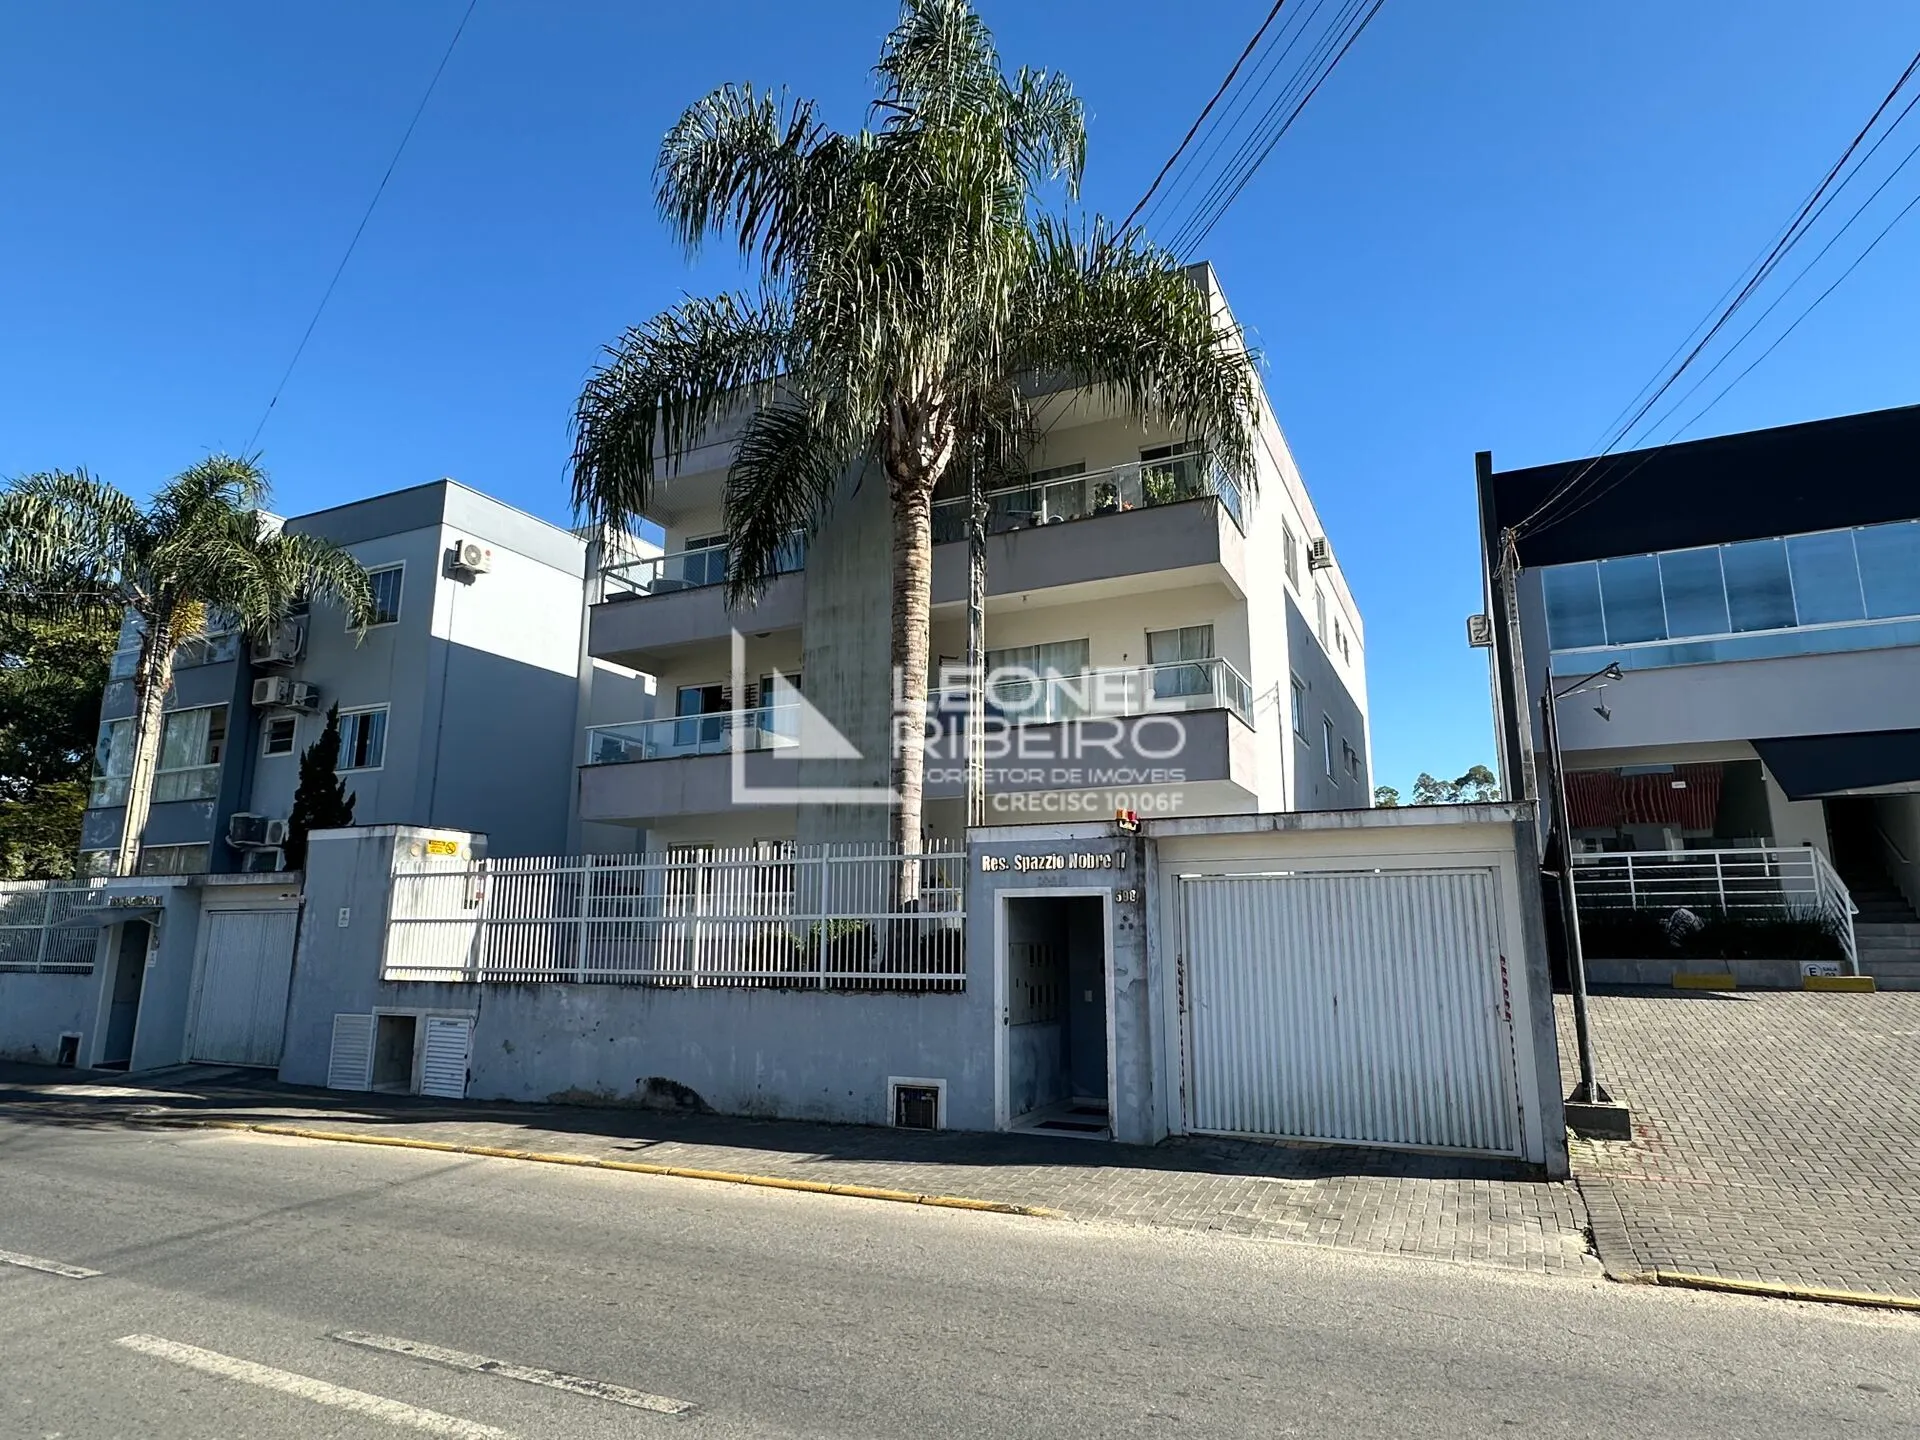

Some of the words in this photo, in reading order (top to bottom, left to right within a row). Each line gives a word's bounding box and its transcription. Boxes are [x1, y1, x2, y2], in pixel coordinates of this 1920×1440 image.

[982, 855, 1009, 871] Res.
[1014, 853, 1064, 873] Spazzio
[1068, 852, 1112, 869] Nobre
